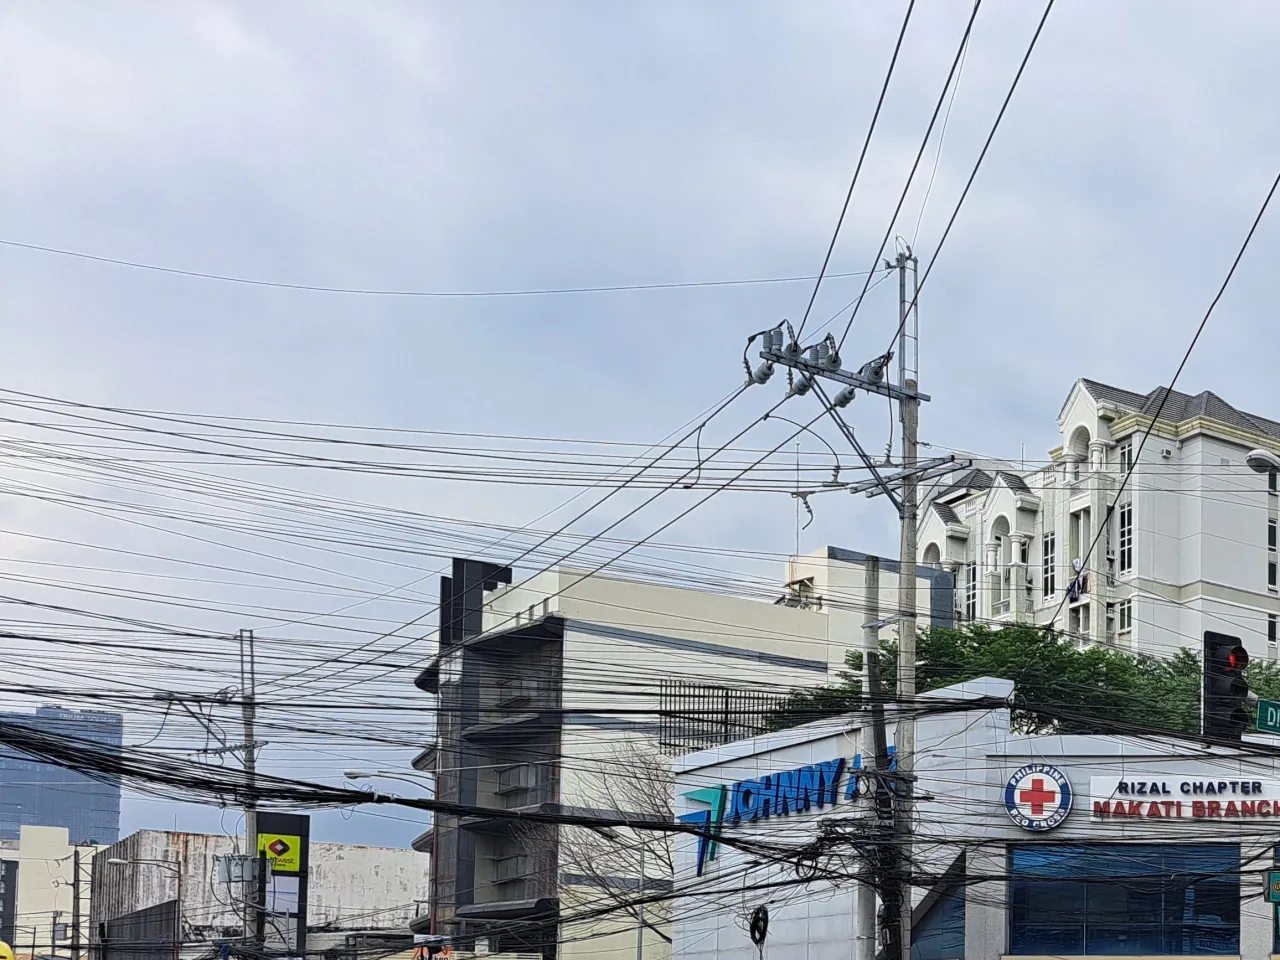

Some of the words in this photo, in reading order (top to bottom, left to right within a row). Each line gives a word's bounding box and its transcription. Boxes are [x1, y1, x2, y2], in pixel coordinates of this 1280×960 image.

[1010, 764, 1066, 786] PHILIPPINE
[723, 757, 846, 824] JOHNNY
[1118, 781, 1171, 795] RIZAL
[1180, 781, 1263, 795] CHAPTER
[1093, 800, 1182, 818] MAKATI
